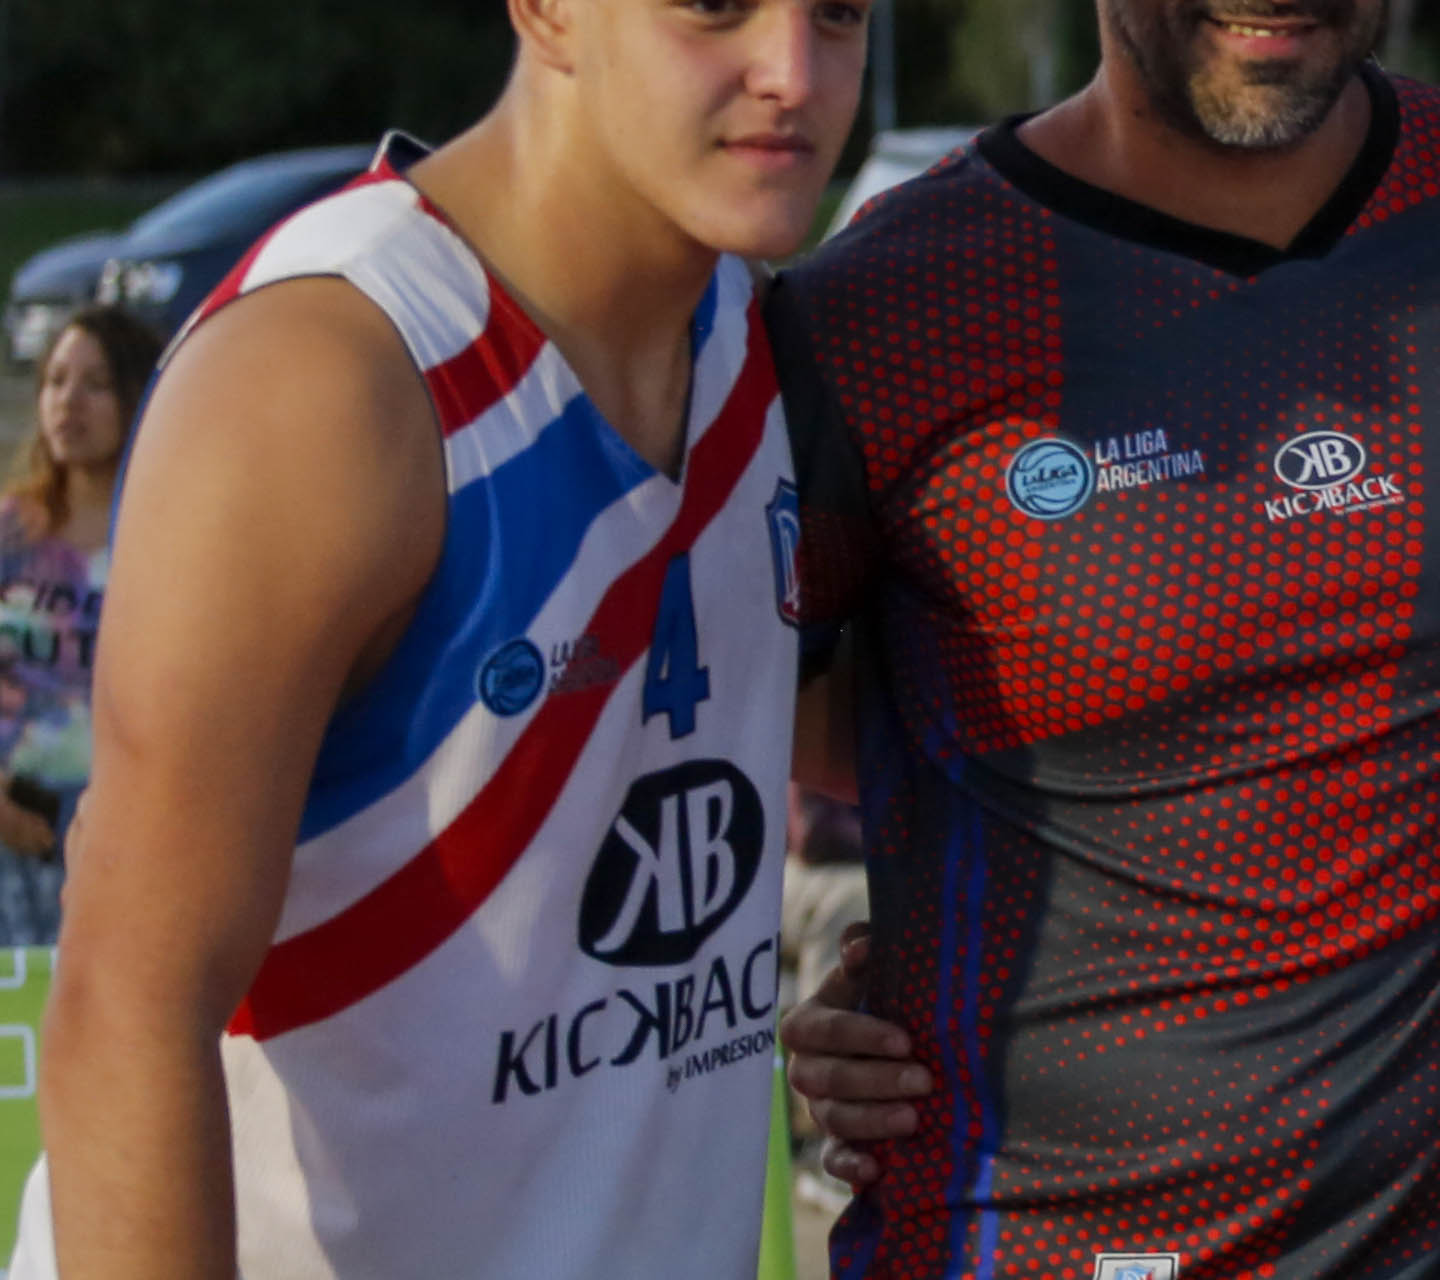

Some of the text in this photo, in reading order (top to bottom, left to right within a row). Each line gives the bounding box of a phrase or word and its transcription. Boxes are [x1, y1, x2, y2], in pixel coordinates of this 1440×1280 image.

[1095, 428, 1167, 465] LA LIGA
[1096, 450, 1205, 493] ARGENTINA
[1264, 474, 1401, 522] KICKBACK
[642, 553, 709, 740] 4
[492, 931, 780, 1104] KICKBAC
